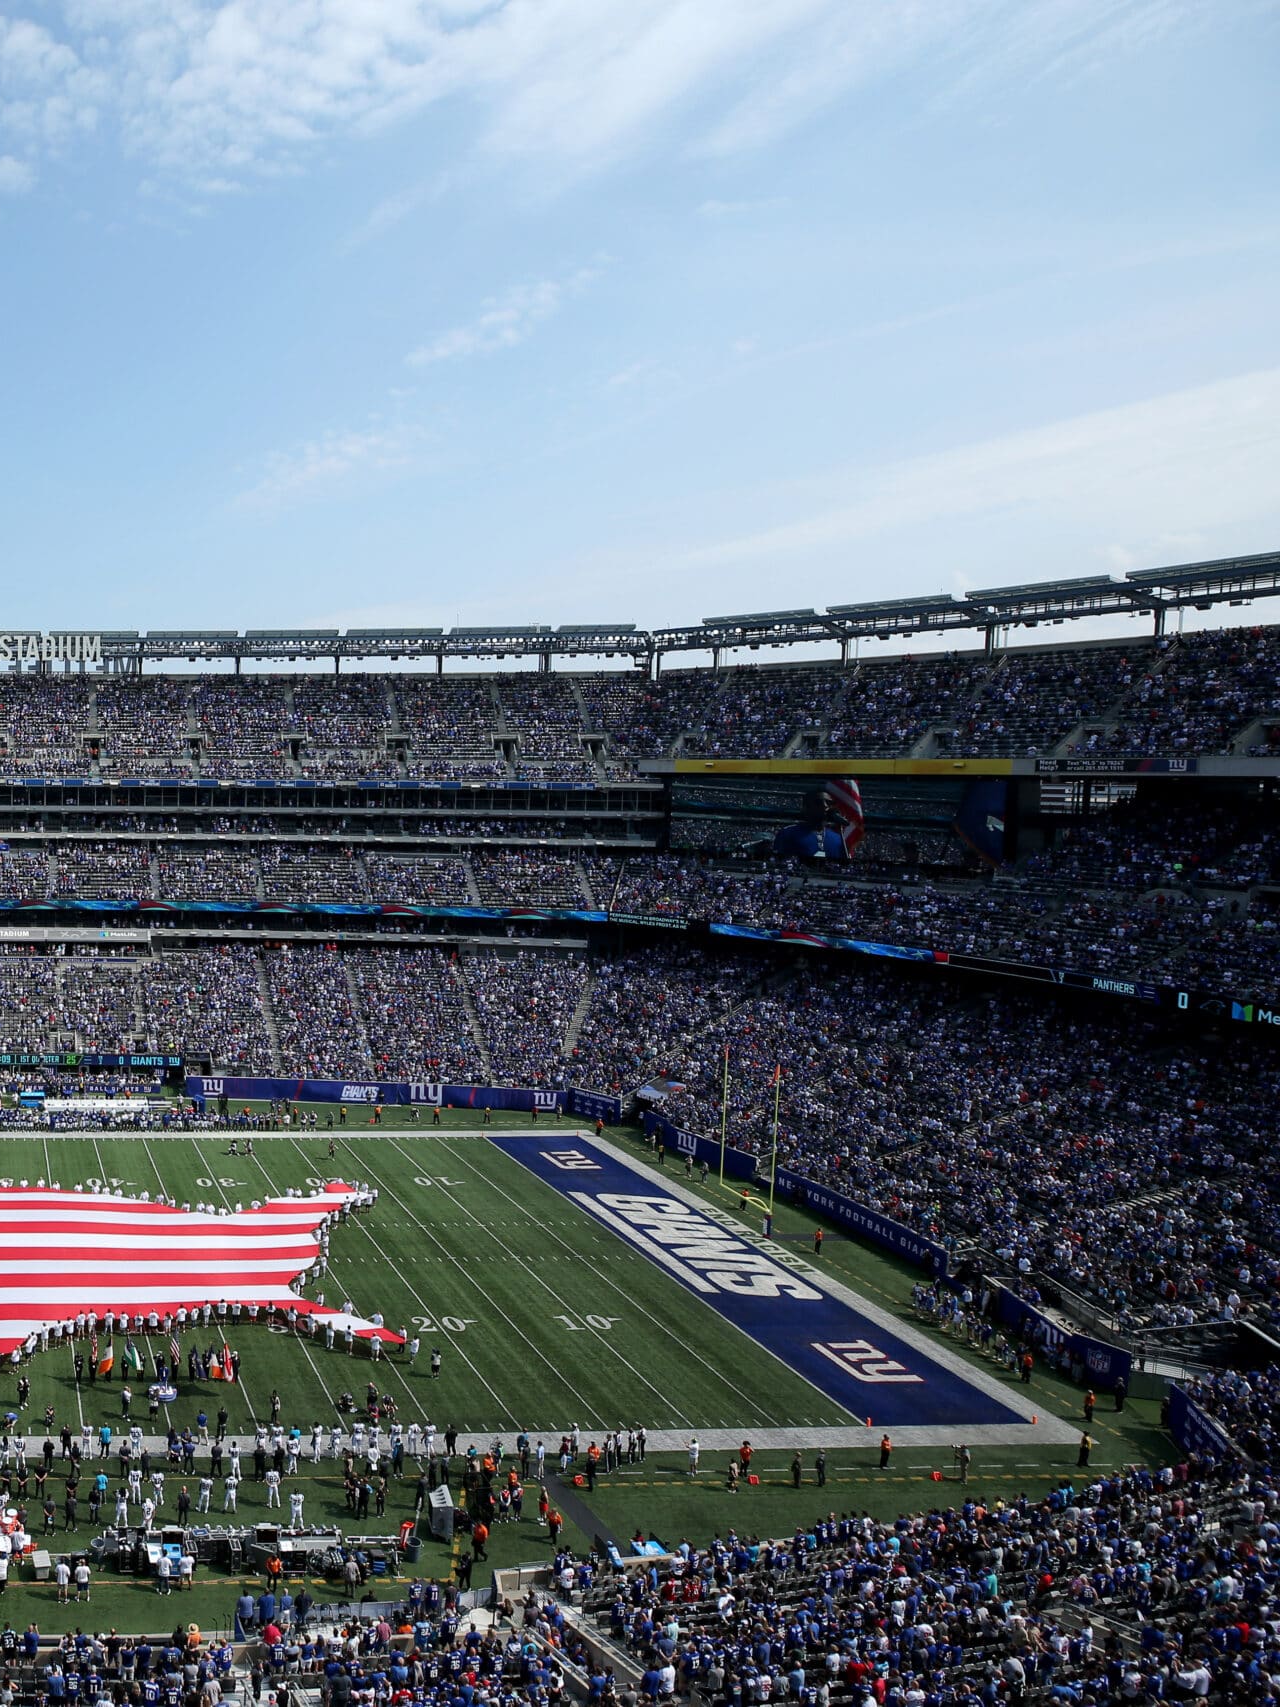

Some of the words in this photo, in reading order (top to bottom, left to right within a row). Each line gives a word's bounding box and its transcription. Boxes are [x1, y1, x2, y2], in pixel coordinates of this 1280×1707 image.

[0, 634, 102, 661] STADIUM
[1168, 759, 1187, 772] ny
[1092, 977, 1135, 995] PANTHERS
[1177, 991, 1189, 1009] 0
[31, 1055, 60, 1064] QURTER
[66, 1055, 76, 1065] 25
[118, 1055, 124, 1065] 0
[131, 1055, 163, 1066] GIANTS
[169, 1056, 180, 1066] ny
[202, 1079, 224, 1096] ny
[341, 1084, 379, 1100] GIANTS
[409, 1083, 443, 1106] ny
[533, 1092, 557, 1110] ny
[676, 1130, 697, 1156] ny
[538, 1149, 604, 1171] ny
[806, 1186, 835, 1209] YORK
[838, 1203, 894, 1242] FOOTBALL
[594, 1192, 824, 1301] GIANTS
[699, 1207, 738, 1227] END
[737, 1228, 817, 1275] RACISM
[411, 1316, 467, 1332] 20
[552, 1314, 613, 1330] 10
[810, 1339, 926, 1384] ny
[431, 1591, 438, 1601] 11
[89, 1684, 98, 1694] 11
[145, 1690, 155, 1701] 10
